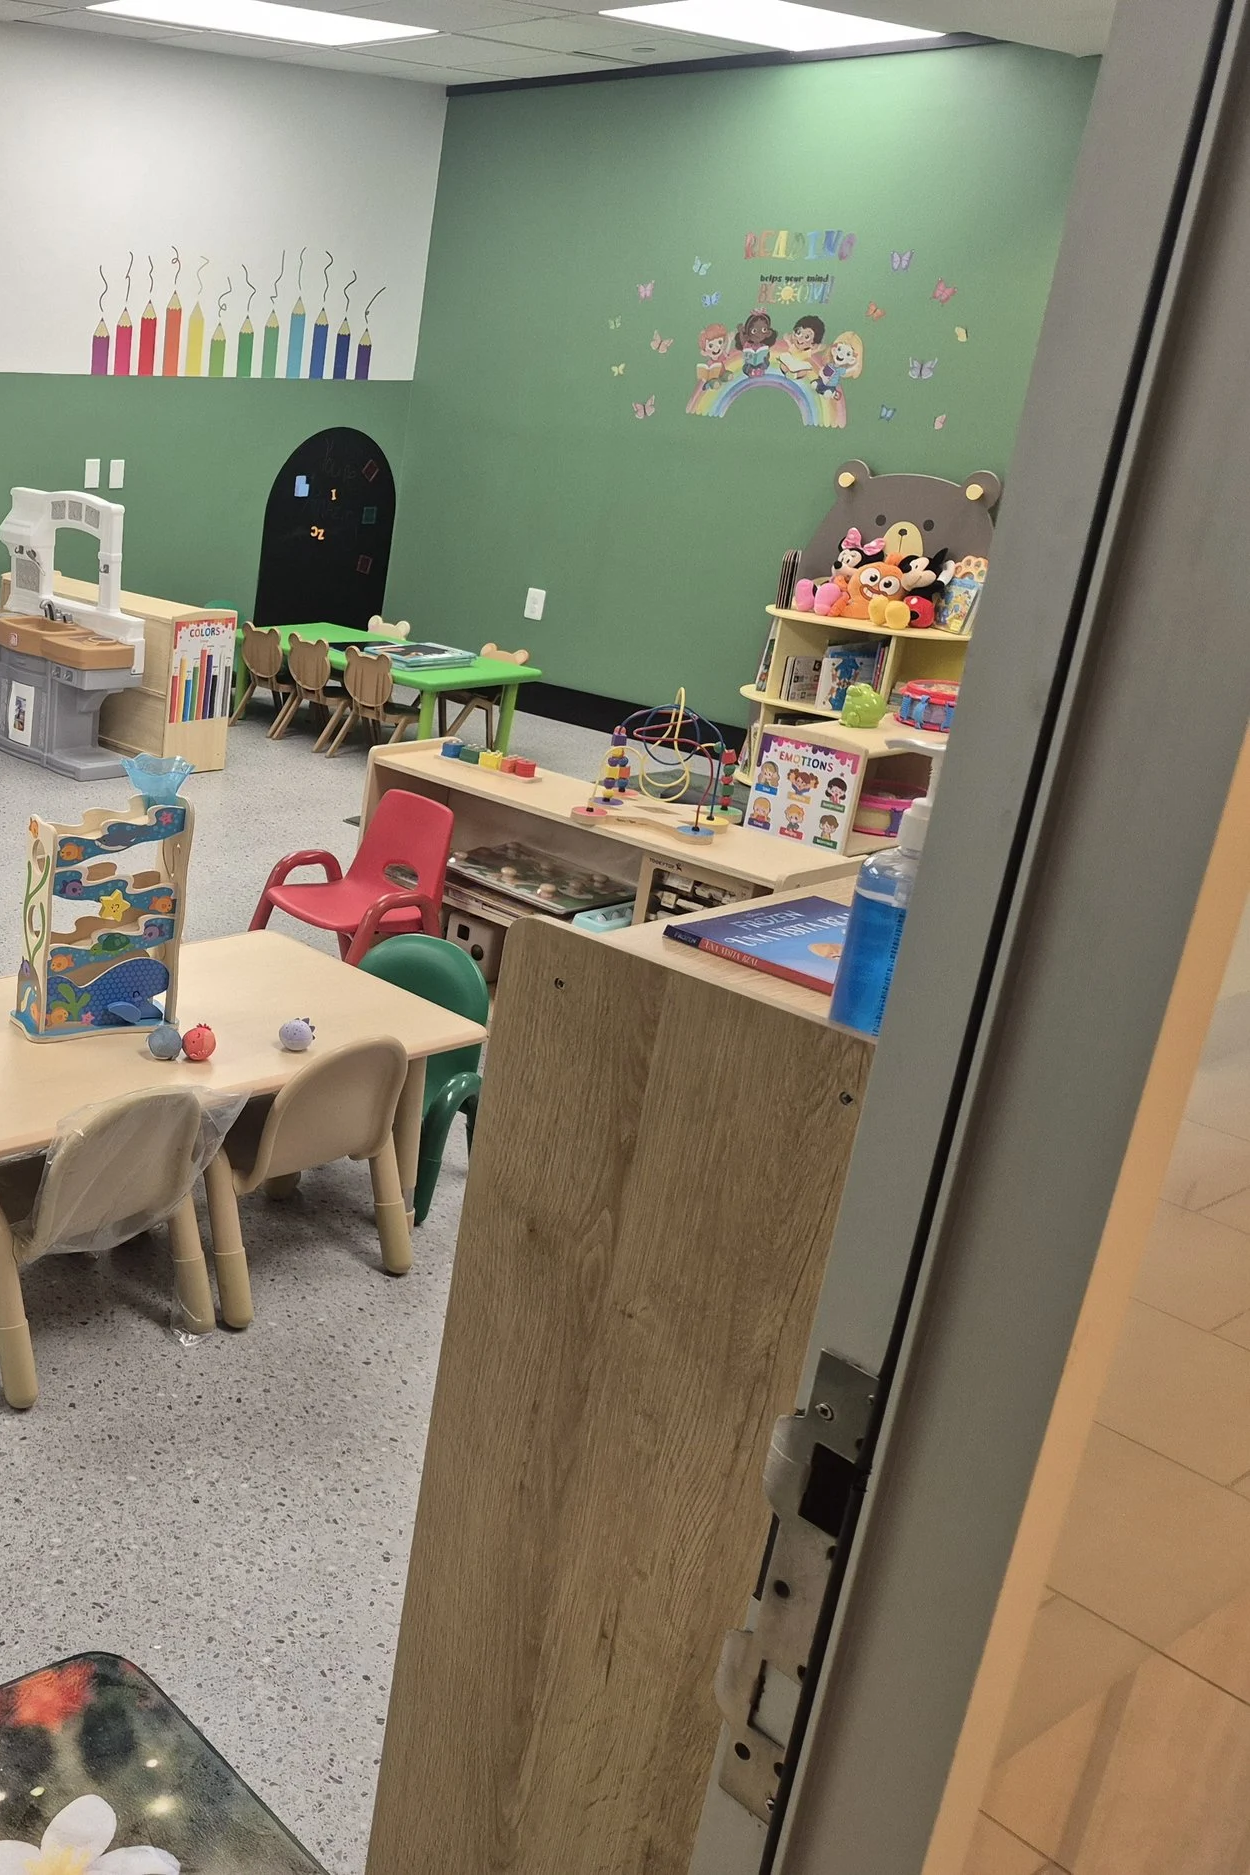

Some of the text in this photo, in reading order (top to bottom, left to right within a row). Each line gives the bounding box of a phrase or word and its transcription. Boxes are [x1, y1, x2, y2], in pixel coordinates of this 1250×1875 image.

[807, 274, 829, 282] mind
[190, 627, 220, 637] COLORS
[779, 751, 834, 772] EMOTIONS
[729, 910, 806, 930] FROZEN
[724, 931, 773, 947] UNA
[767, 921, 830, 940] VISITA
[742, 953, 759, 965] REAL
